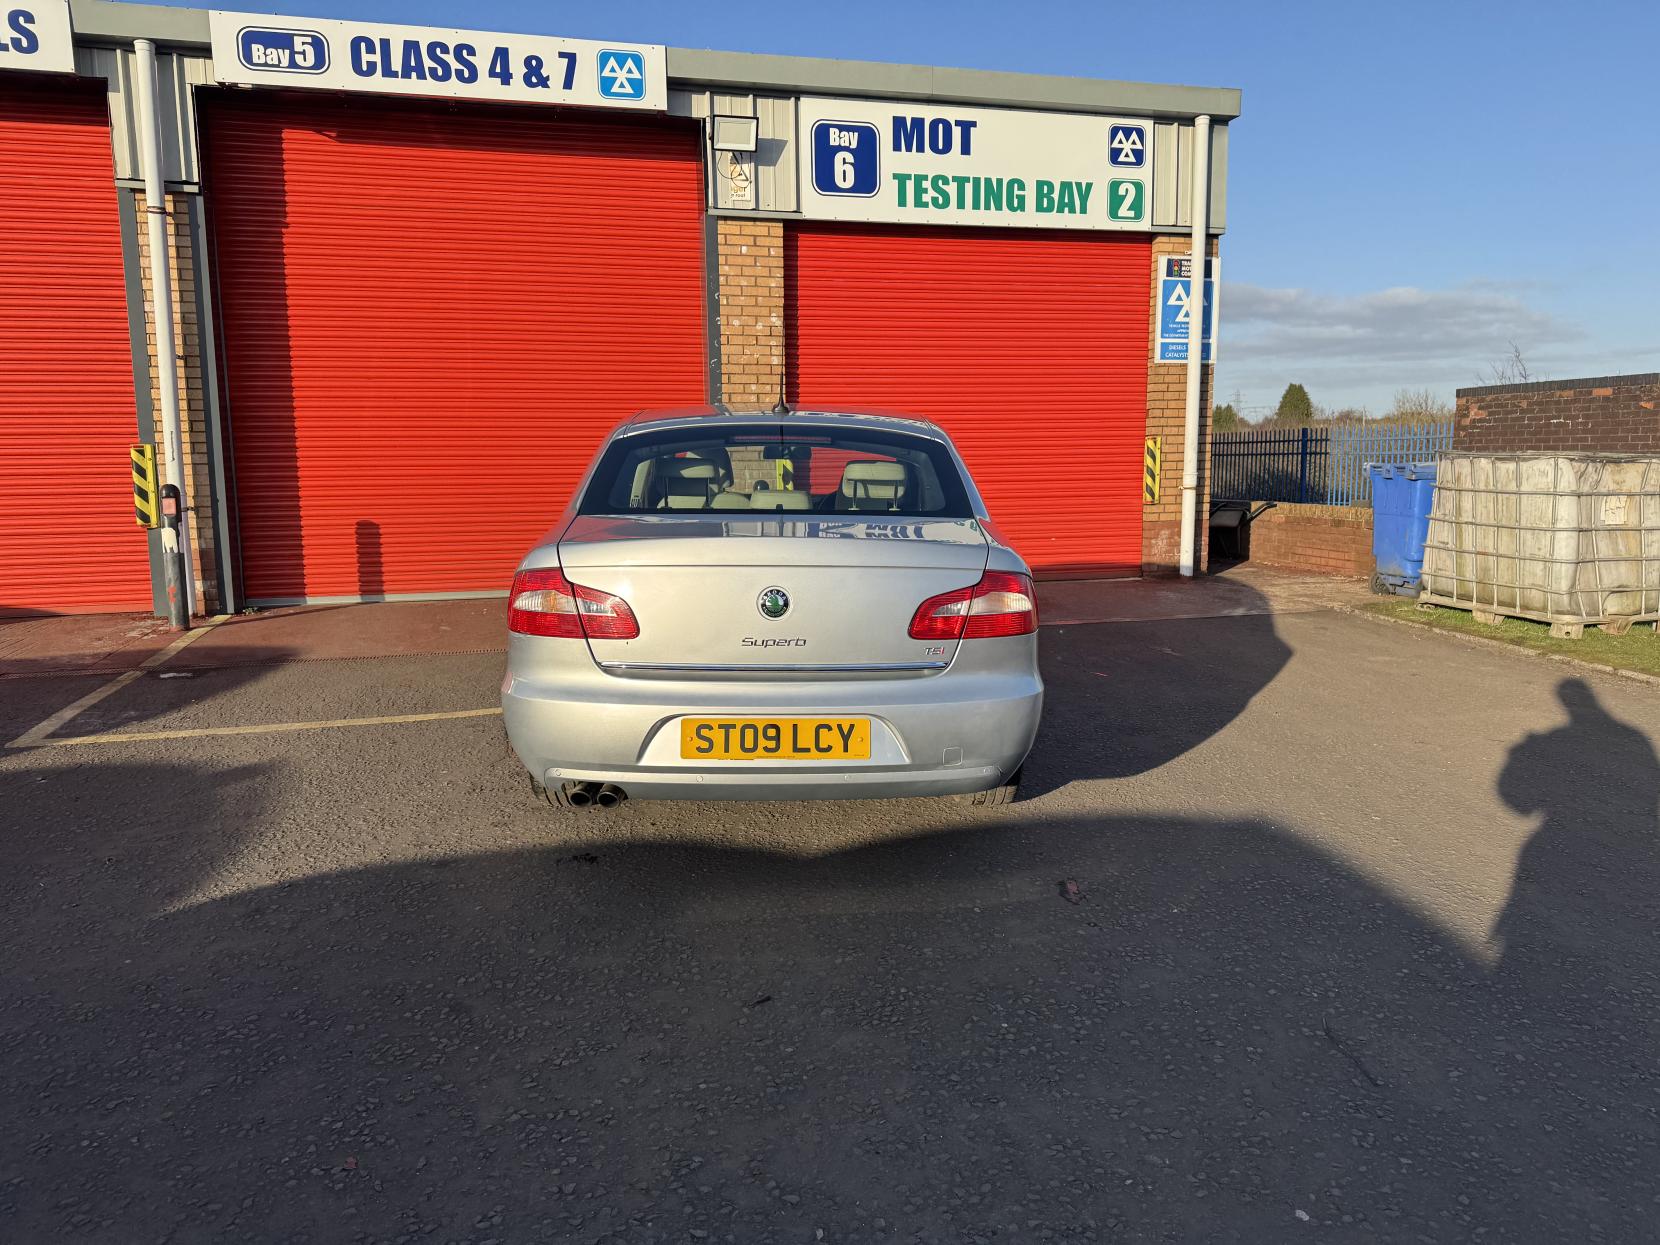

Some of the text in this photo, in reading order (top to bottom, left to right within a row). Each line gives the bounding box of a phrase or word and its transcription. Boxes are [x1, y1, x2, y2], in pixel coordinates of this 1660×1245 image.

[251, 36, 315, 67] Bay 5
[350, 35, 577, 90] CLASS 4 & 7
[829, 128, 859, 149] Bay
[892, 115, 978, 156] MOT
[834, 151, 855, 189] 6
[892, 172, 1094, 215] TESTING BAY
[1117, 182, 1137, 218] 2
[741, 637, 806, 648] Superb
[695, 723, 856, 754] ST09 LCY
